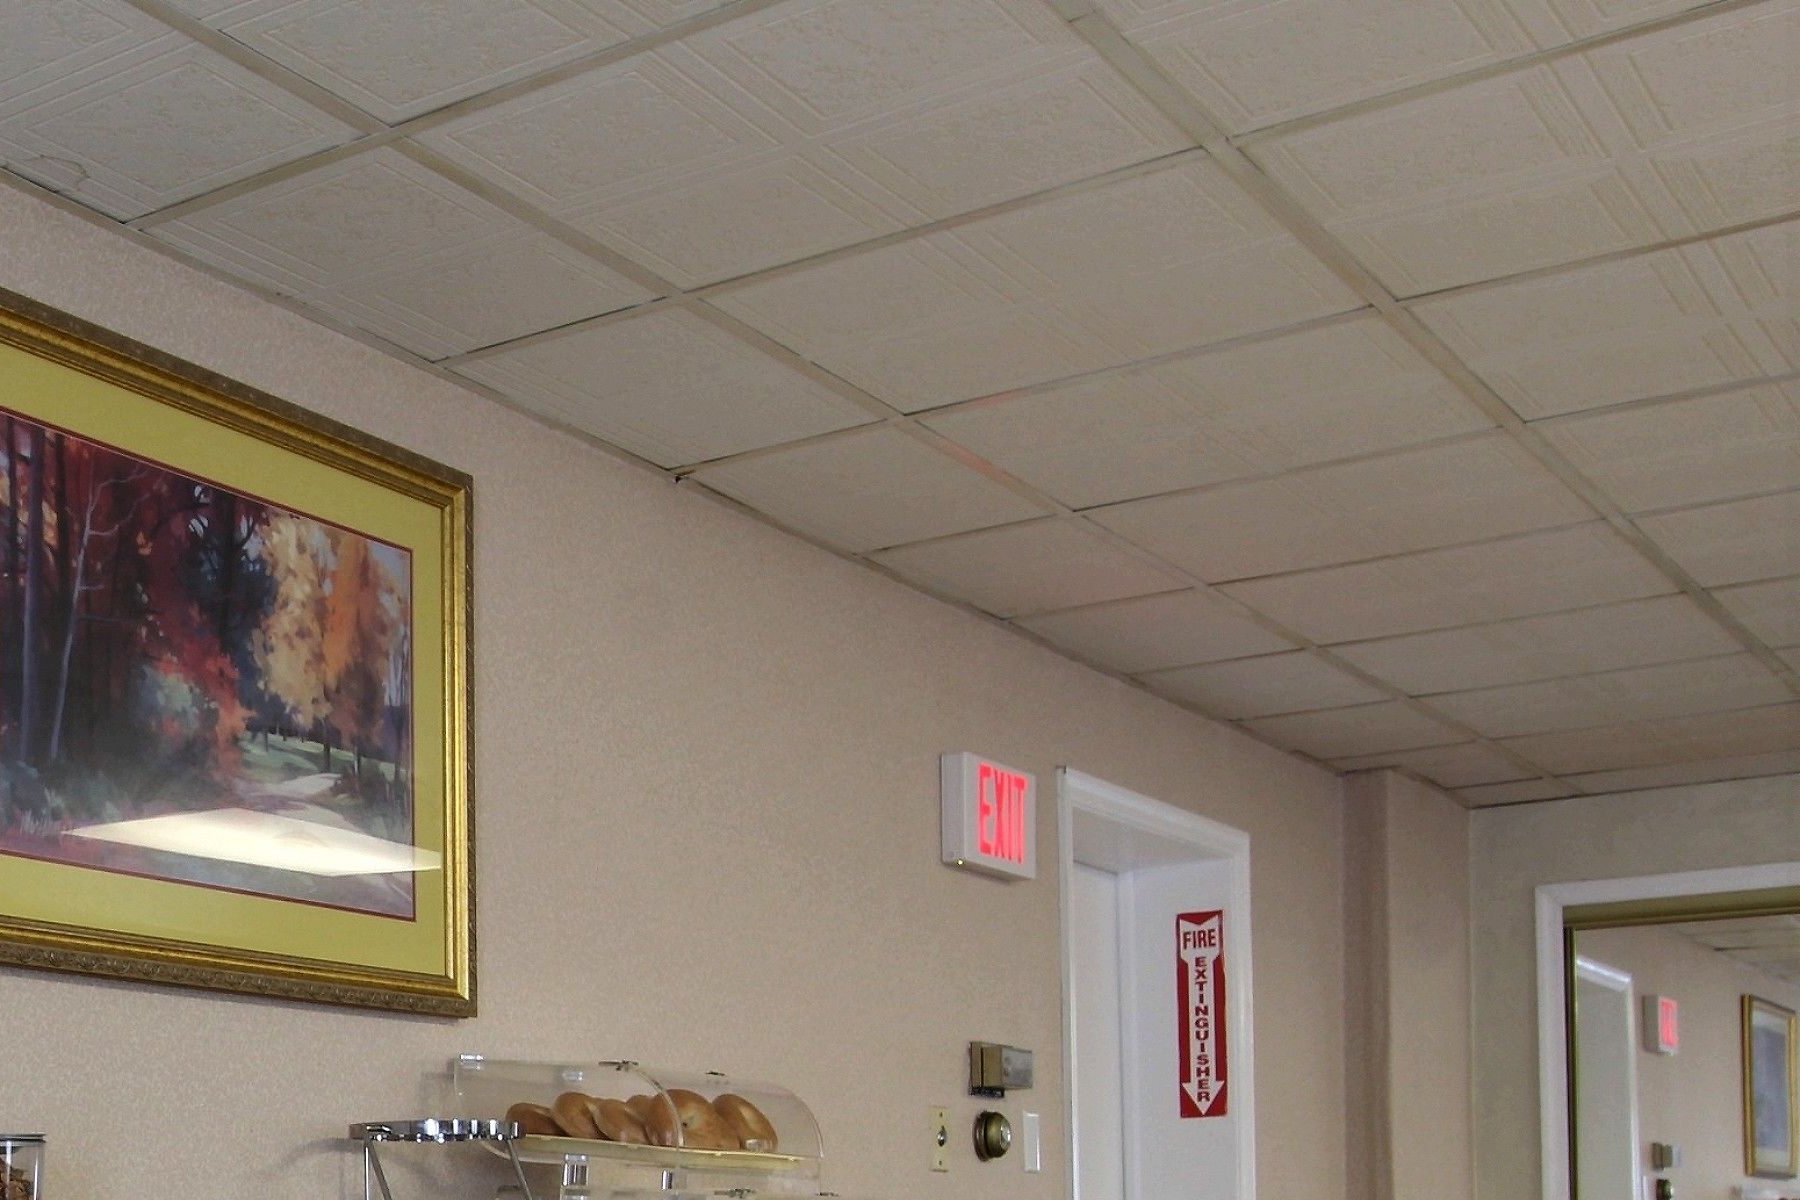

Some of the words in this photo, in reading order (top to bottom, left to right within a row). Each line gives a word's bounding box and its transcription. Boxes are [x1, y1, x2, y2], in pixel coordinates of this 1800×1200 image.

[978, 761, 1028, 865] EXIT
[1182, 928, 1217, 950] FIRE
[1194, 956, 1211, 1103] EXTINGUISHER
